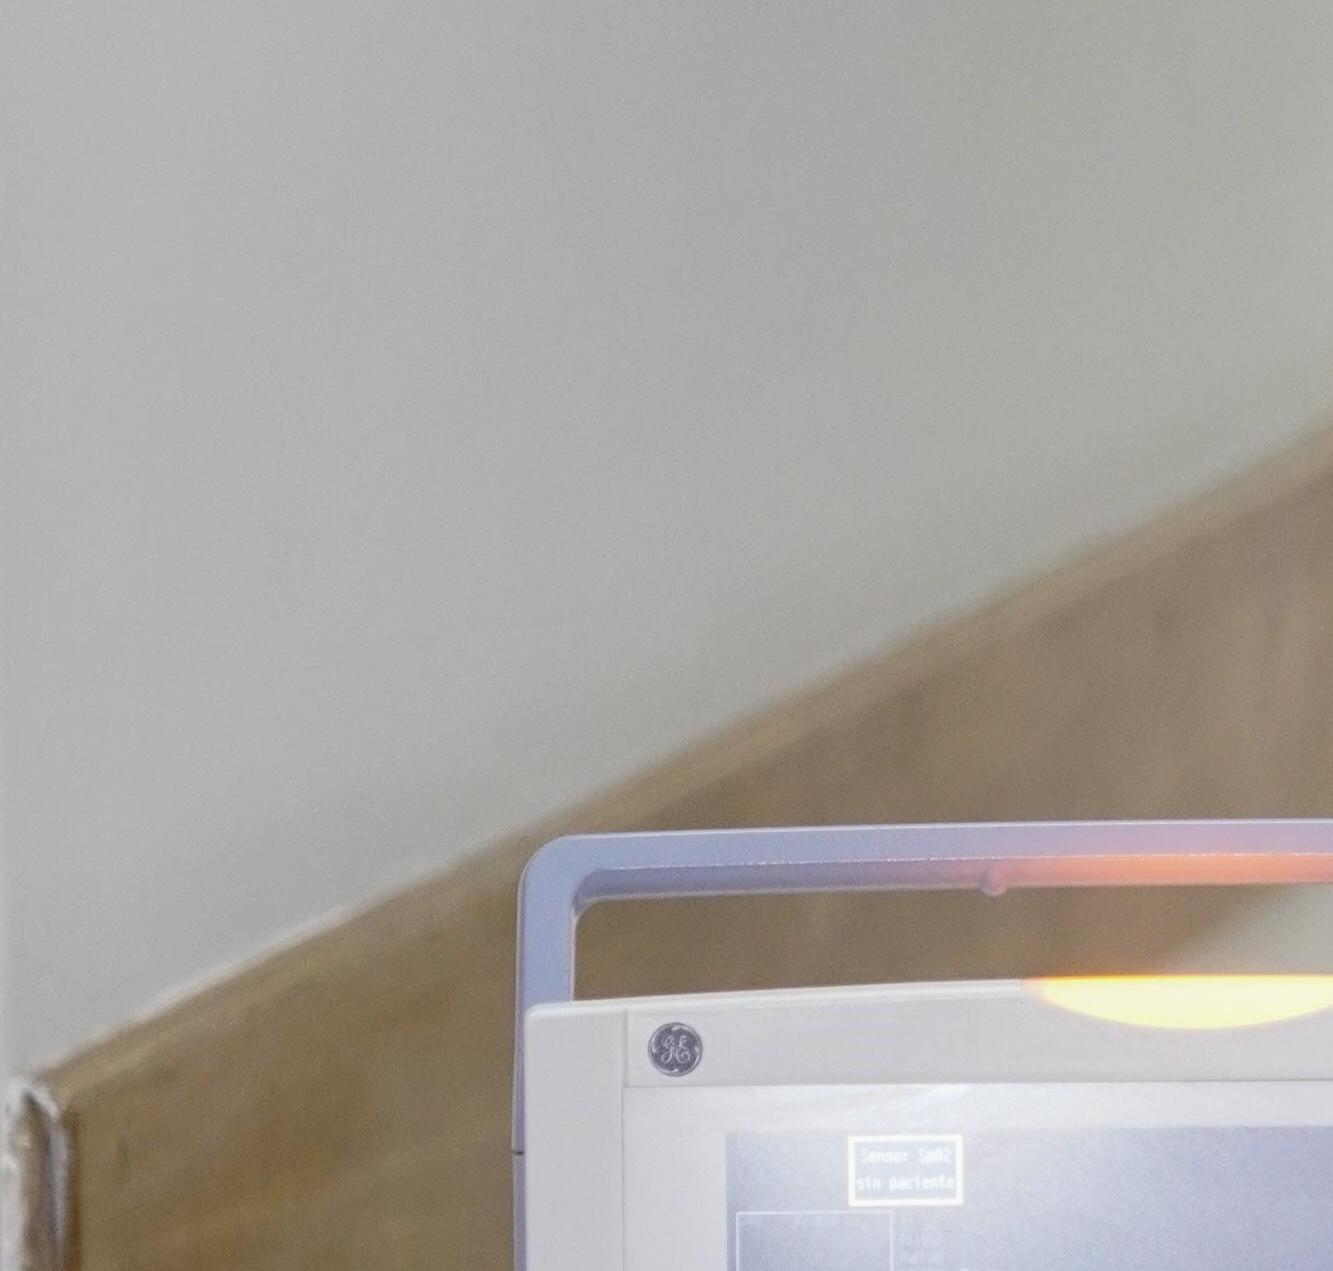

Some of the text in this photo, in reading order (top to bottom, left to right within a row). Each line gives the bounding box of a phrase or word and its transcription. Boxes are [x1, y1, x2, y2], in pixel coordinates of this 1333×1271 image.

[860, 1147, 909, 1163] Sensor
[857, 1174, 955, 1193] sin paciente
